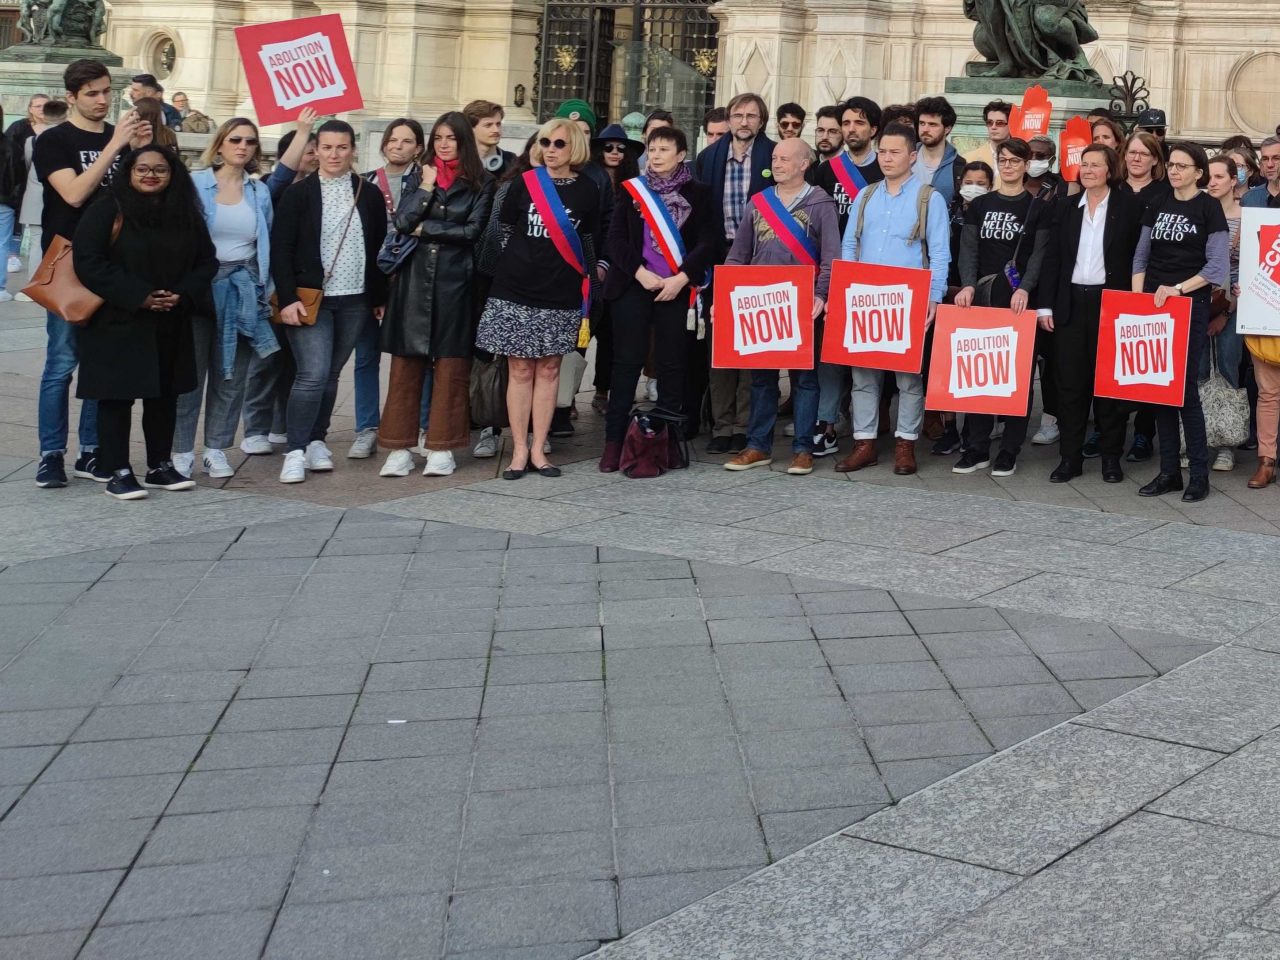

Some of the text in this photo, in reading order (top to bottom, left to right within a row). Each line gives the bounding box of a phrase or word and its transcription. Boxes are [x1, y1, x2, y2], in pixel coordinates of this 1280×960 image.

[268, 40, 324, 68] ABOLITION
[273, 54, 336, 101] NOW
[984, 211, 1012, 222] FREE
[1157, 212, 1183, 224] FREE
[980, 228, 1014, 240] LUCIO
[981, 220, 1026, 235] MELISSA
[1150, 229, 1183, 241] LUCIO
[1152, 221, 1197, 235] MELISSA
[737, 290, 790, 311] ABOLITION
[851, 292, 904, 308] ABOLITION
[739, 305, 794, 346] NOW
[852, 307, 905, 344] NOW
[1120, 322, 1167, 339] ABOLITION
[956, 334, 1010, 353] ABOLITION
[1120, 337, 1168, 377] NOW
[956, 350, 1010, 389] NOW
